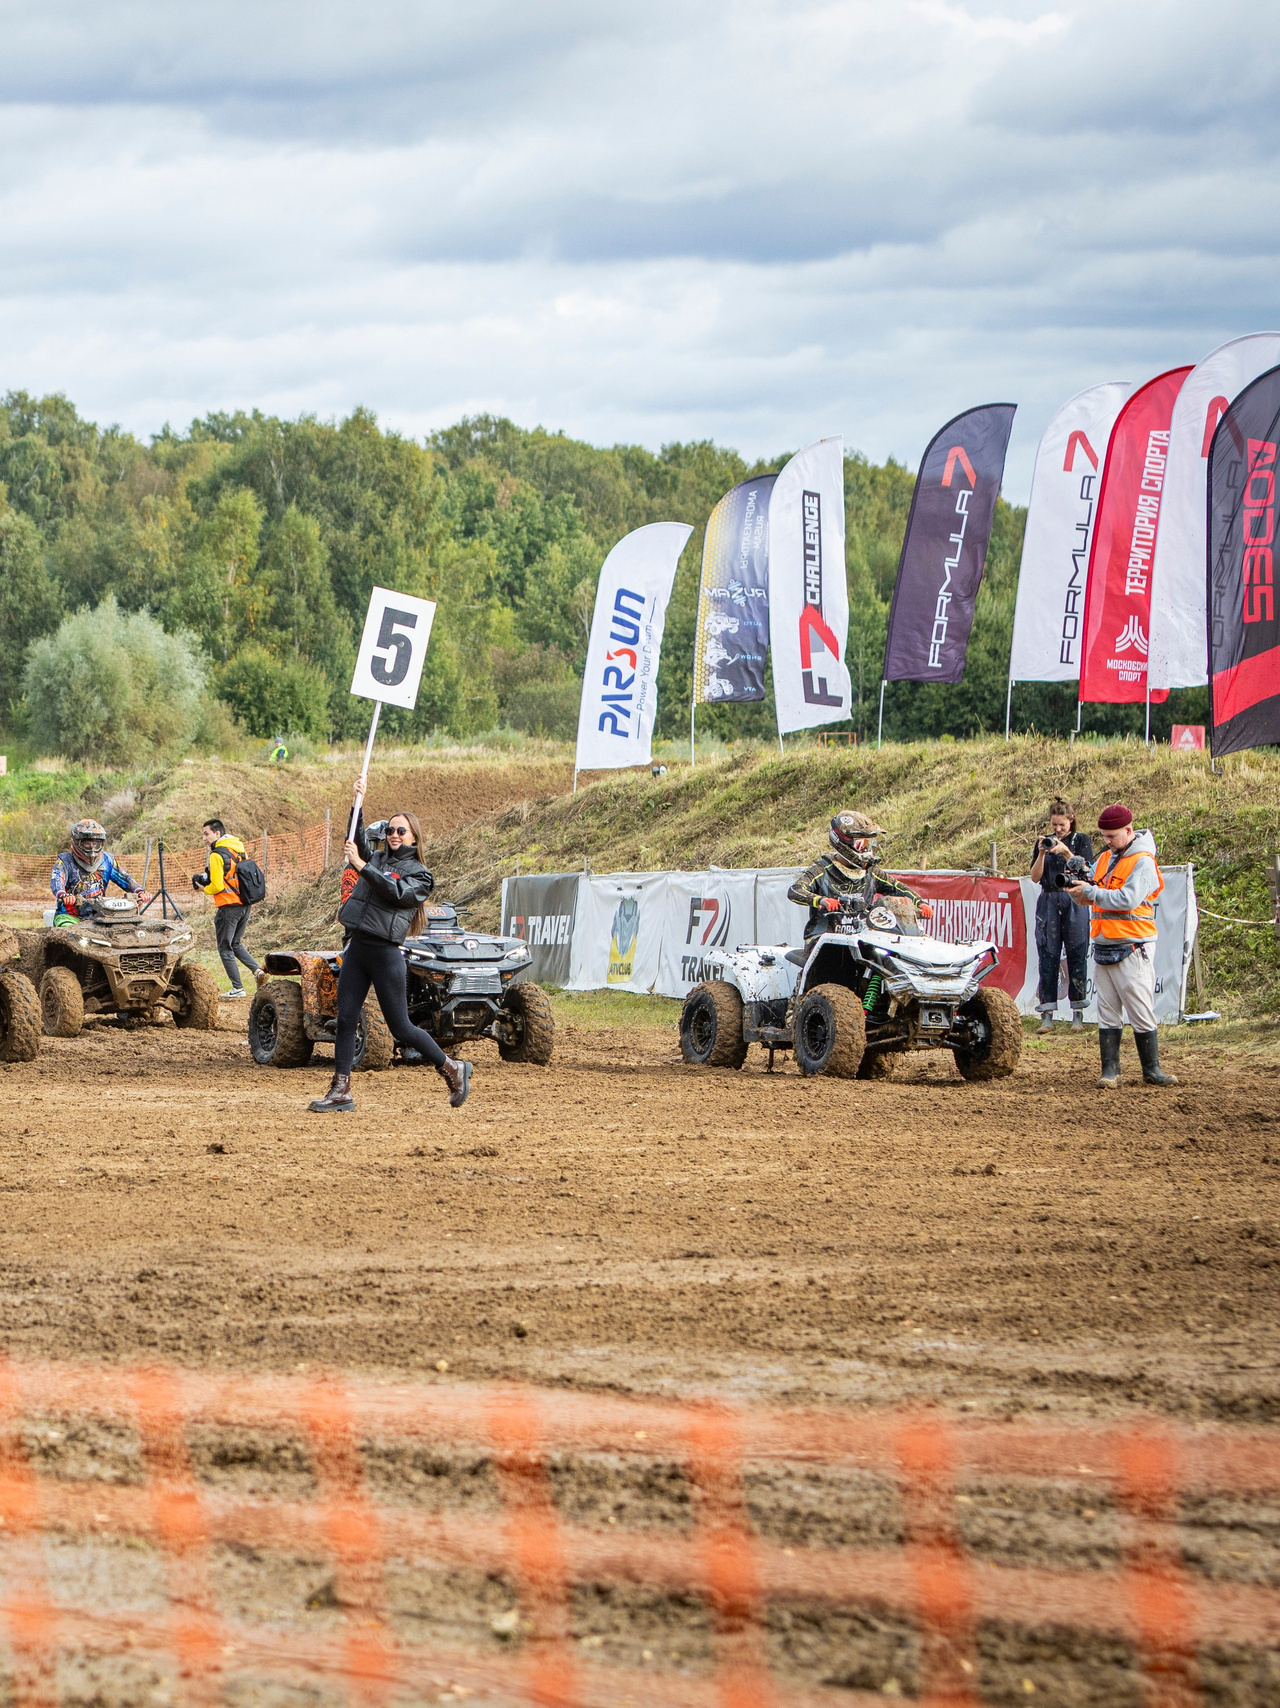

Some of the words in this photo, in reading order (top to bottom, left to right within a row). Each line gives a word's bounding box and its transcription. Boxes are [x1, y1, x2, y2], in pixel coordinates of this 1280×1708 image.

[941, 445, 977, 489] 7
[1063, 430, 1099, 473] 7
[1141, 430, 1171, 491] СПОРТА
[804, 494, 820, 605] CHALLENGE
[1125, 494, 1159, 596] ТЕРРИТОРИЯ
[1242, 469, 1275, 624] ODES
[927, 489, 974, 668] FORMULA
[1060, 475, 1097, 665] FORMULA
[371, 606, 418, 686] 5
[598, 588, 646, 738] PARSUN
[642, 624, 653, 653] Dam
[640, 655, 651, 677] Your
[1106, 659, 1148, 672] МОСКОВСКИ
[1118, 670, 1142, 682] СПОРТ
[636, 679, 648, 712] Power
[527, 915, 571, 945] TRAVEL
[685, 897, 720, 946] F7
